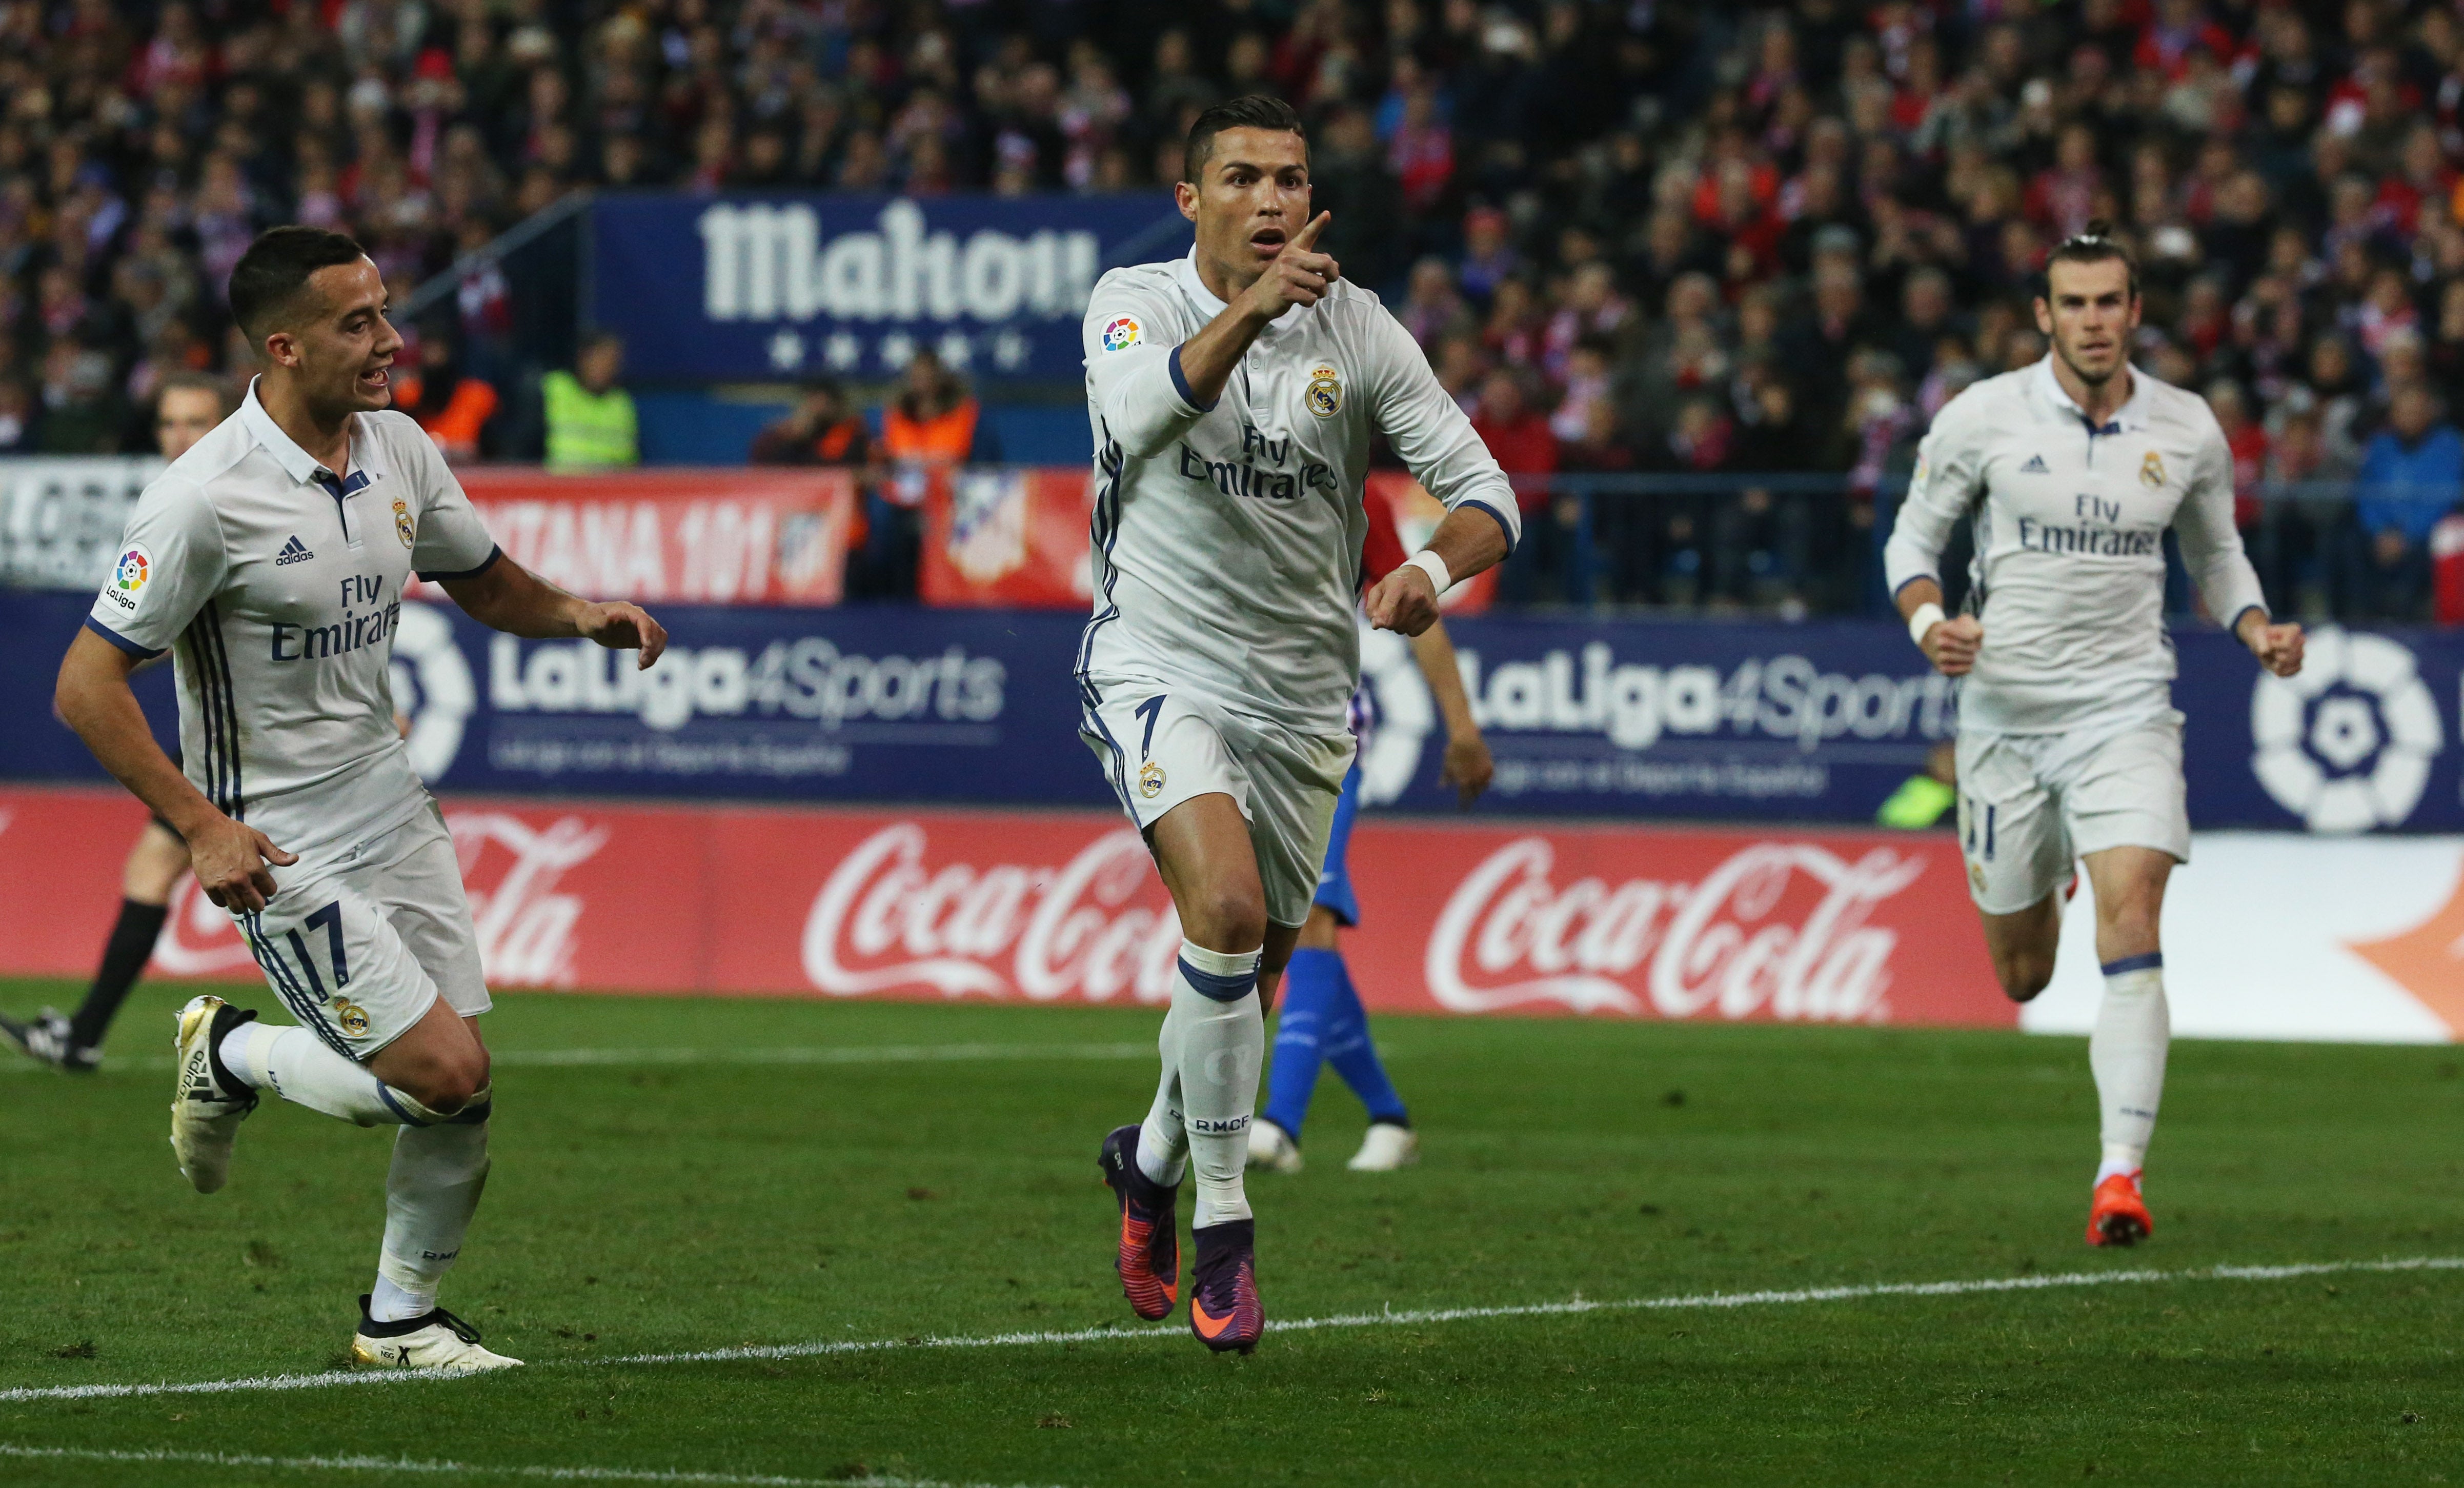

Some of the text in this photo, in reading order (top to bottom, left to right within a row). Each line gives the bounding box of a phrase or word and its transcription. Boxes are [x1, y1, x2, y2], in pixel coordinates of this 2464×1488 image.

[699, 202, 1099, 322] Mahou
[1243, 425, 1288, 468] Fly
[1179, 440, 1338, 499] Emirates
[2076, 493, 2120, 523] Fly
[276, 551, 314, 566] adidas
[106, 585, 135, 610] LaLiga
[340, 575, 382, 608] Fly
[1456, 644, 1958, 748] LaLiga4Sport
[1135, 694, 1167, 765] 7
[1425, 837, 1930, 1020] Coca-Cola
[286, 900, 350, 1004] 17
[178, 1051, 204, 1099] adida
[1196, 1115, 1249, 1132] RMCF
[381, 1350, 394, 1359] NSG
